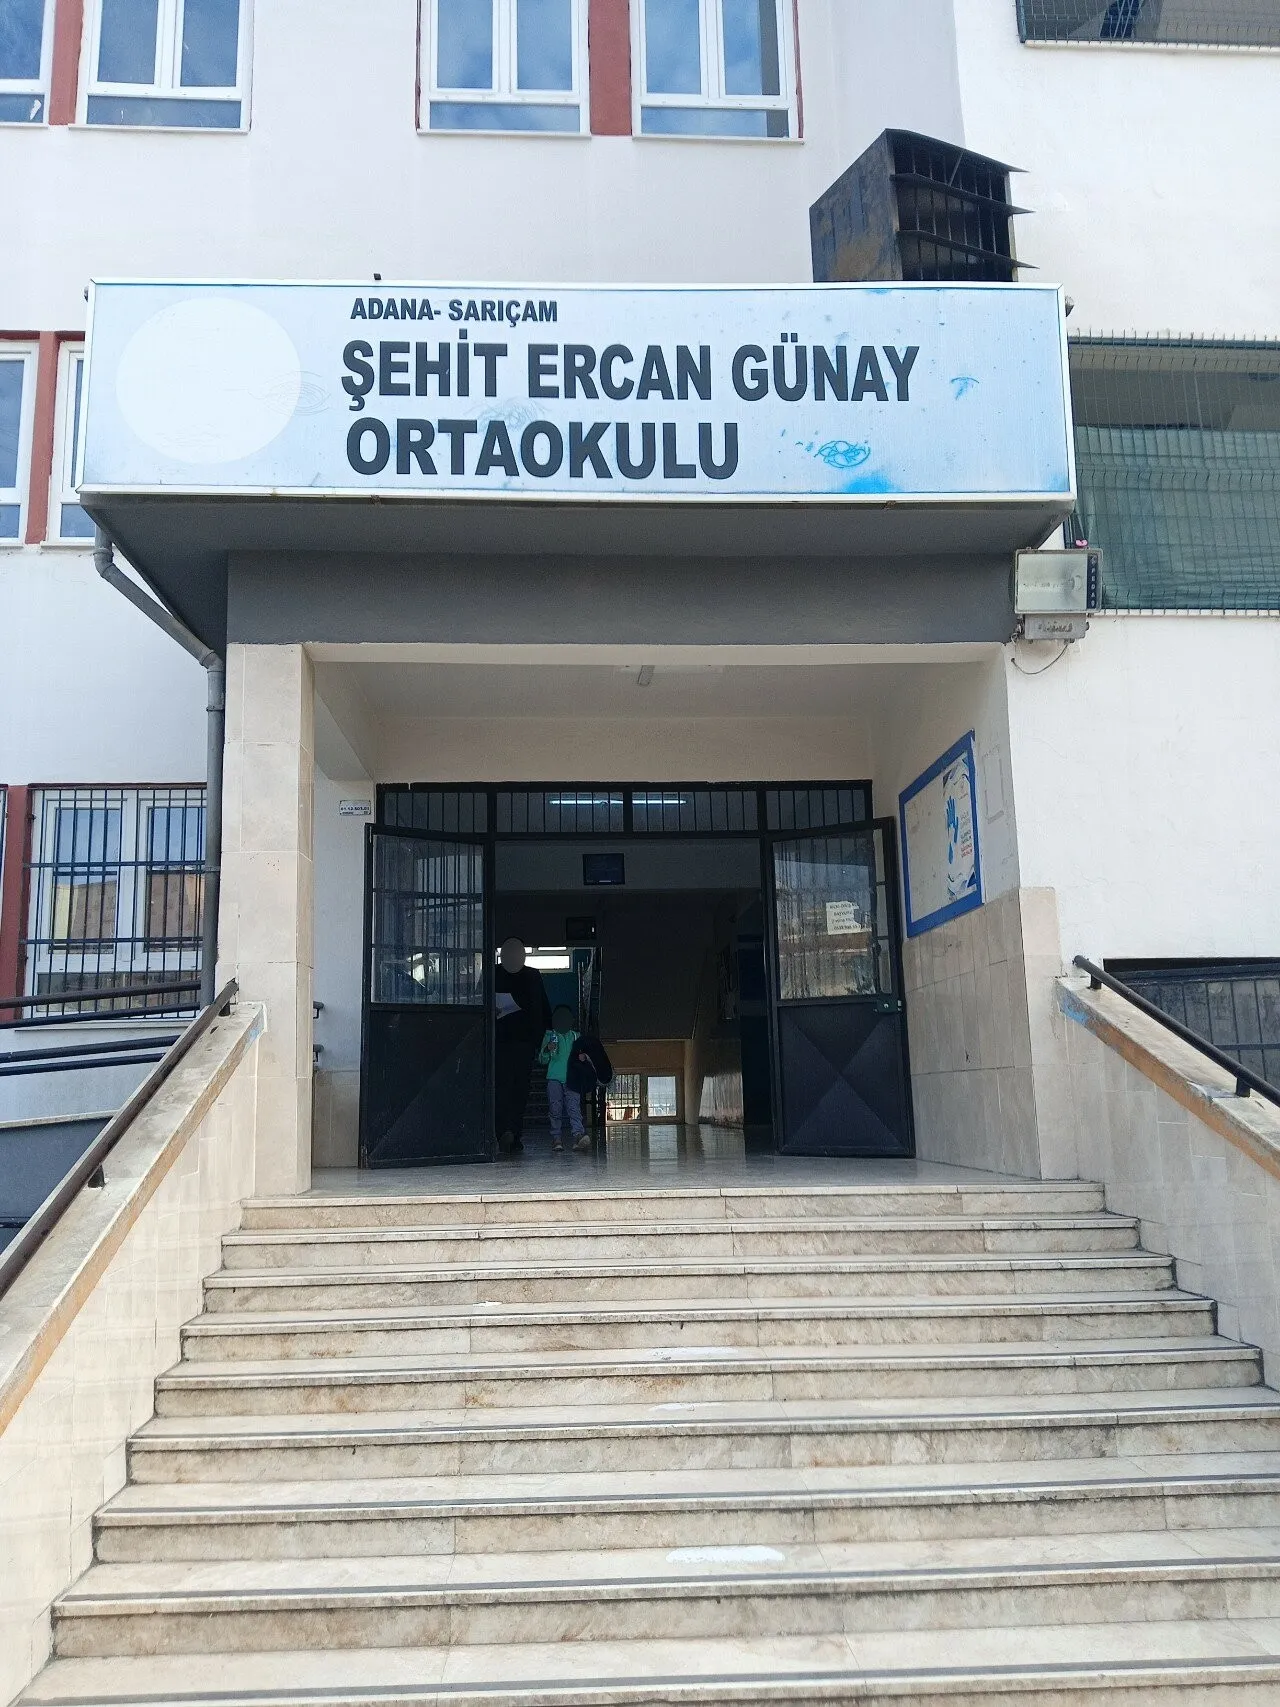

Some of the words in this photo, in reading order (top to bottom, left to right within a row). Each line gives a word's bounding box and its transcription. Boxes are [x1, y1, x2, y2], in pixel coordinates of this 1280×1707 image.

[350, 297, 442, 321] ADANA-
[448, 299, 558, 328] SARIÇAM
[340, 328, 508, 412] ŞEHİT
[527, 343, 712, 401] ERCAN
[731, 332, 920, 402] GÜNAY
[346, 416, 739, 480] ORTAOKULU
